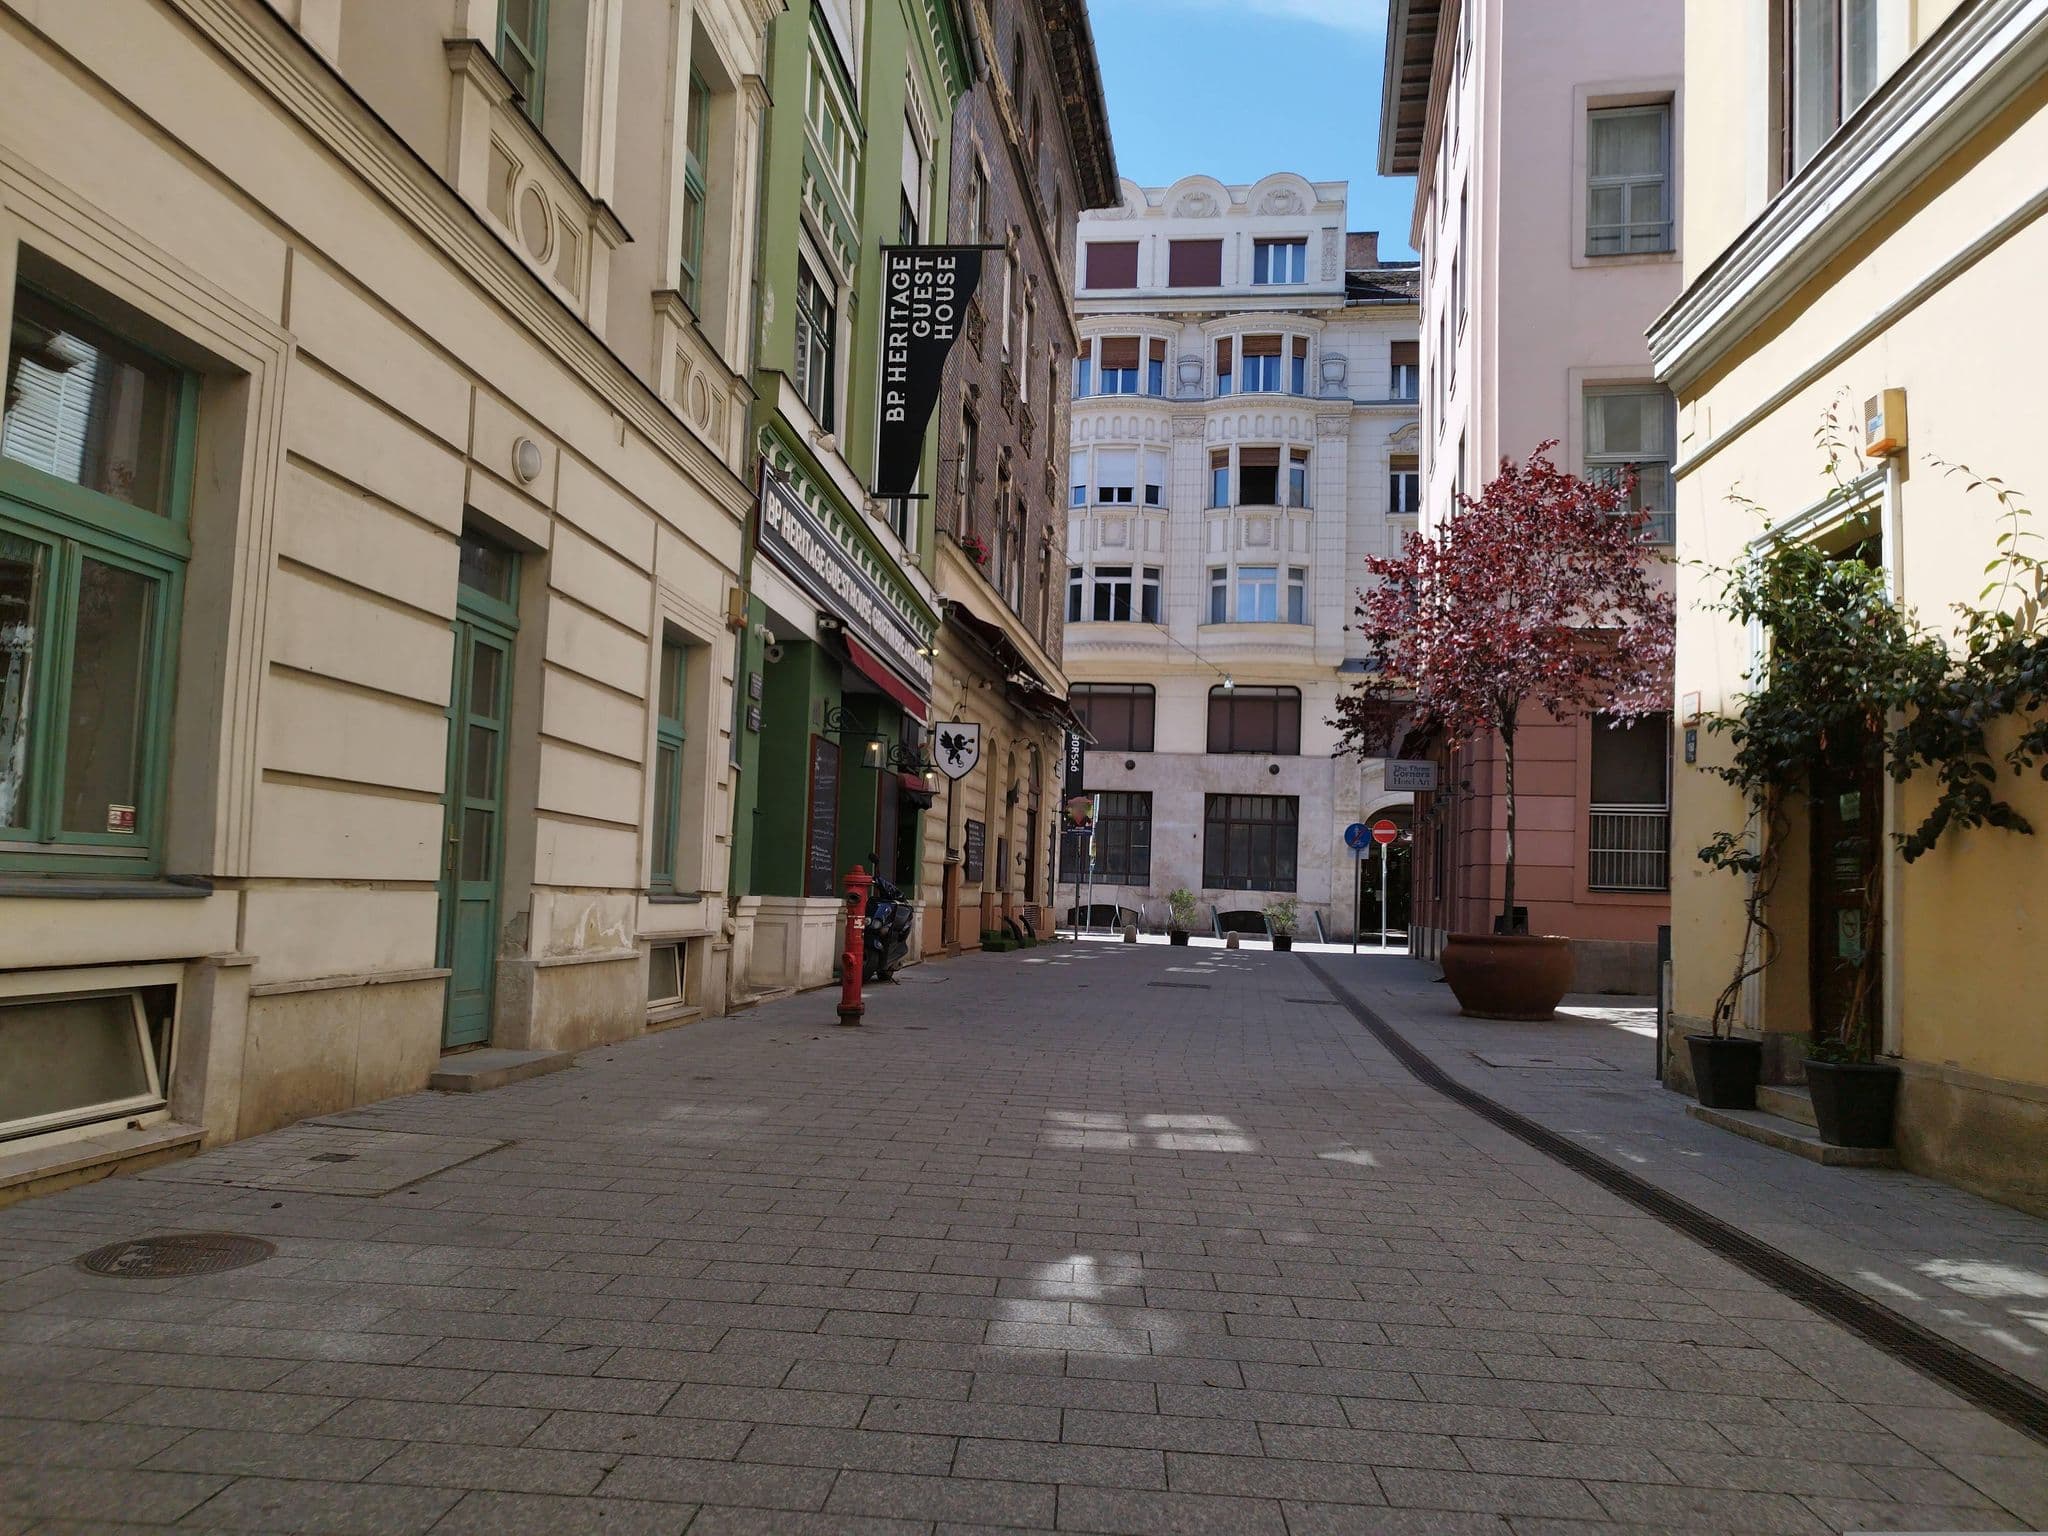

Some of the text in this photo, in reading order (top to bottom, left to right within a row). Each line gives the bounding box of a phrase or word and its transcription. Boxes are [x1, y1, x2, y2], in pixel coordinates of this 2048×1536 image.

[912, 257, 934, 338] GUEST
[934, 256, 956, 340] HOUSE
[886, 257, 911, 422] BP. HERITAGE
[780, 506, 826, 579] HERITAGE
